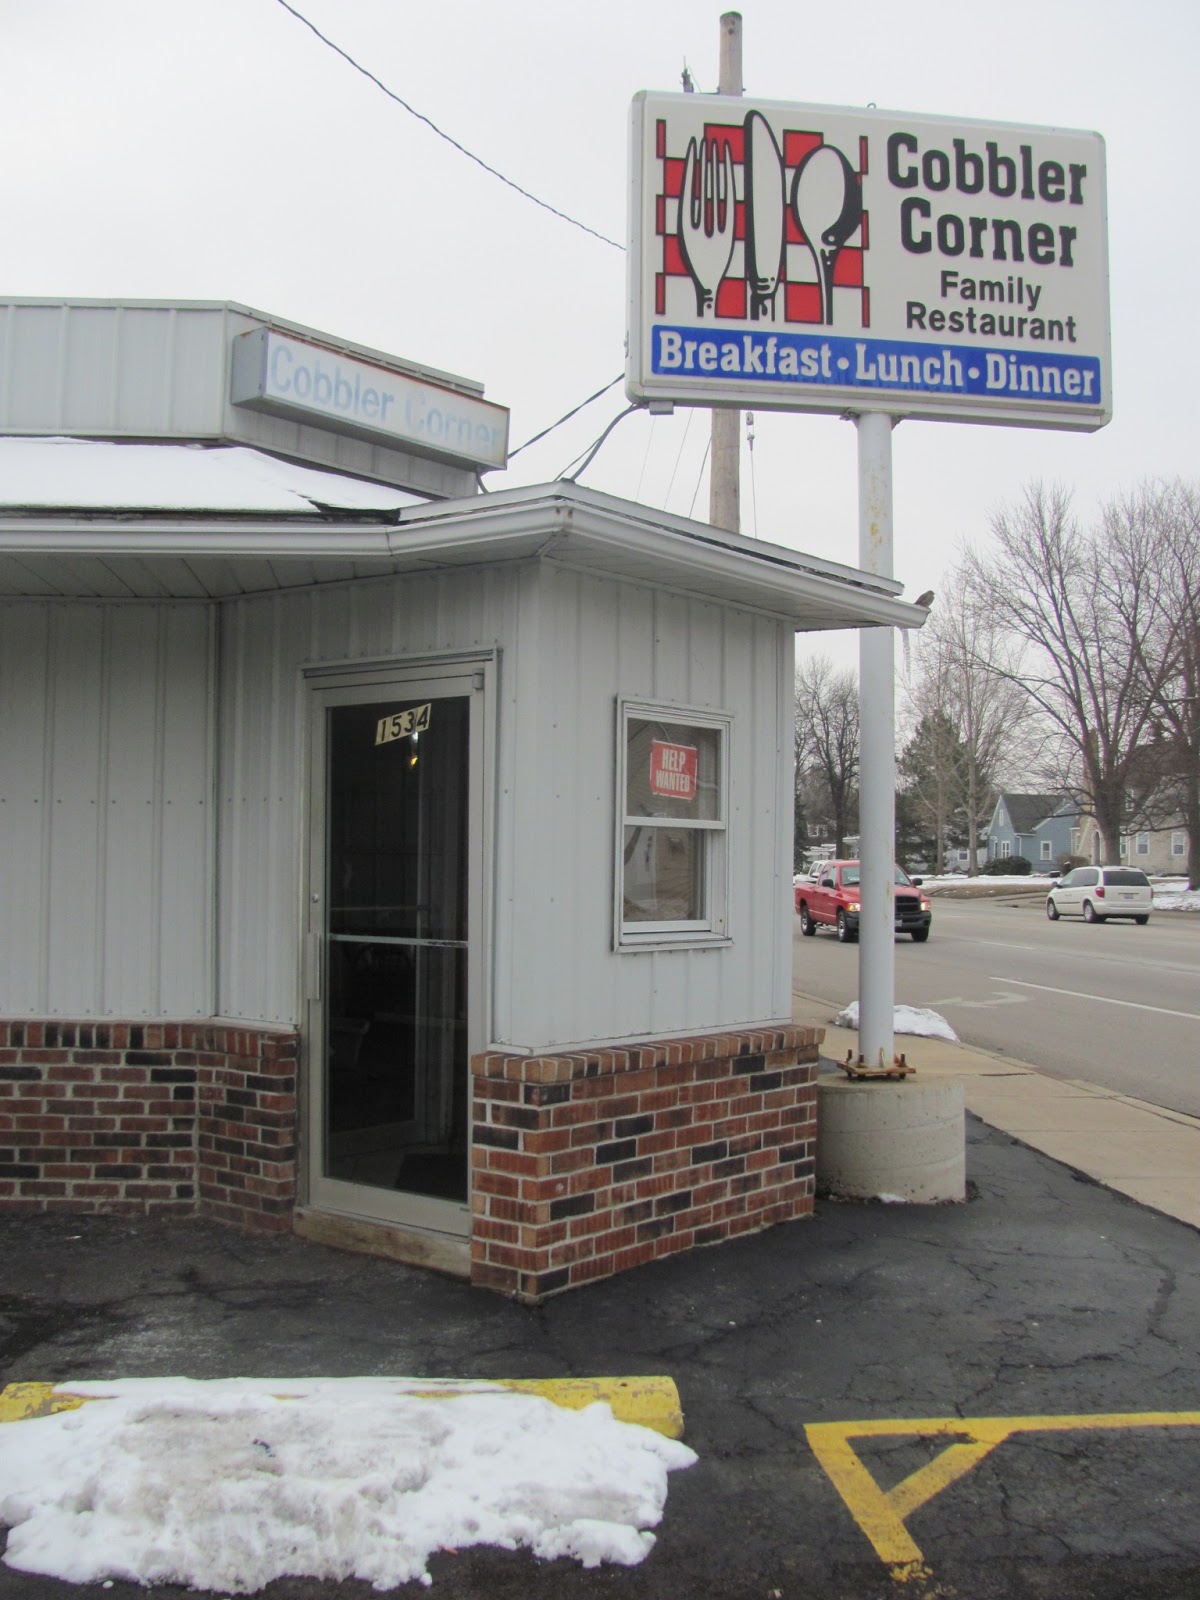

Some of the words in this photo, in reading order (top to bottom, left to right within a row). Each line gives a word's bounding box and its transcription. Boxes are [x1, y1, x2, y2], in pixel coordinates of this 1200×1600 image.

[887, 132, 1086, 204] Cobbler
[900, 197, 1077, 266] Corner
[940, 271, 1042, 311] Family
[906, 302, 1076, 343] Restaurant
[658, 331, 832, 379] Breakfast
[855, 344, 964, 387] Lunch
[985, 354, 1095, 397] Dinner
[271, 345, 394, 422] Cobbler
[405, 388, 500, 447] Corner
[381, 706, 429, 741] 1534
[662, 748, 686, 772] HELP
[656, 770, 690, 793] WANTED
